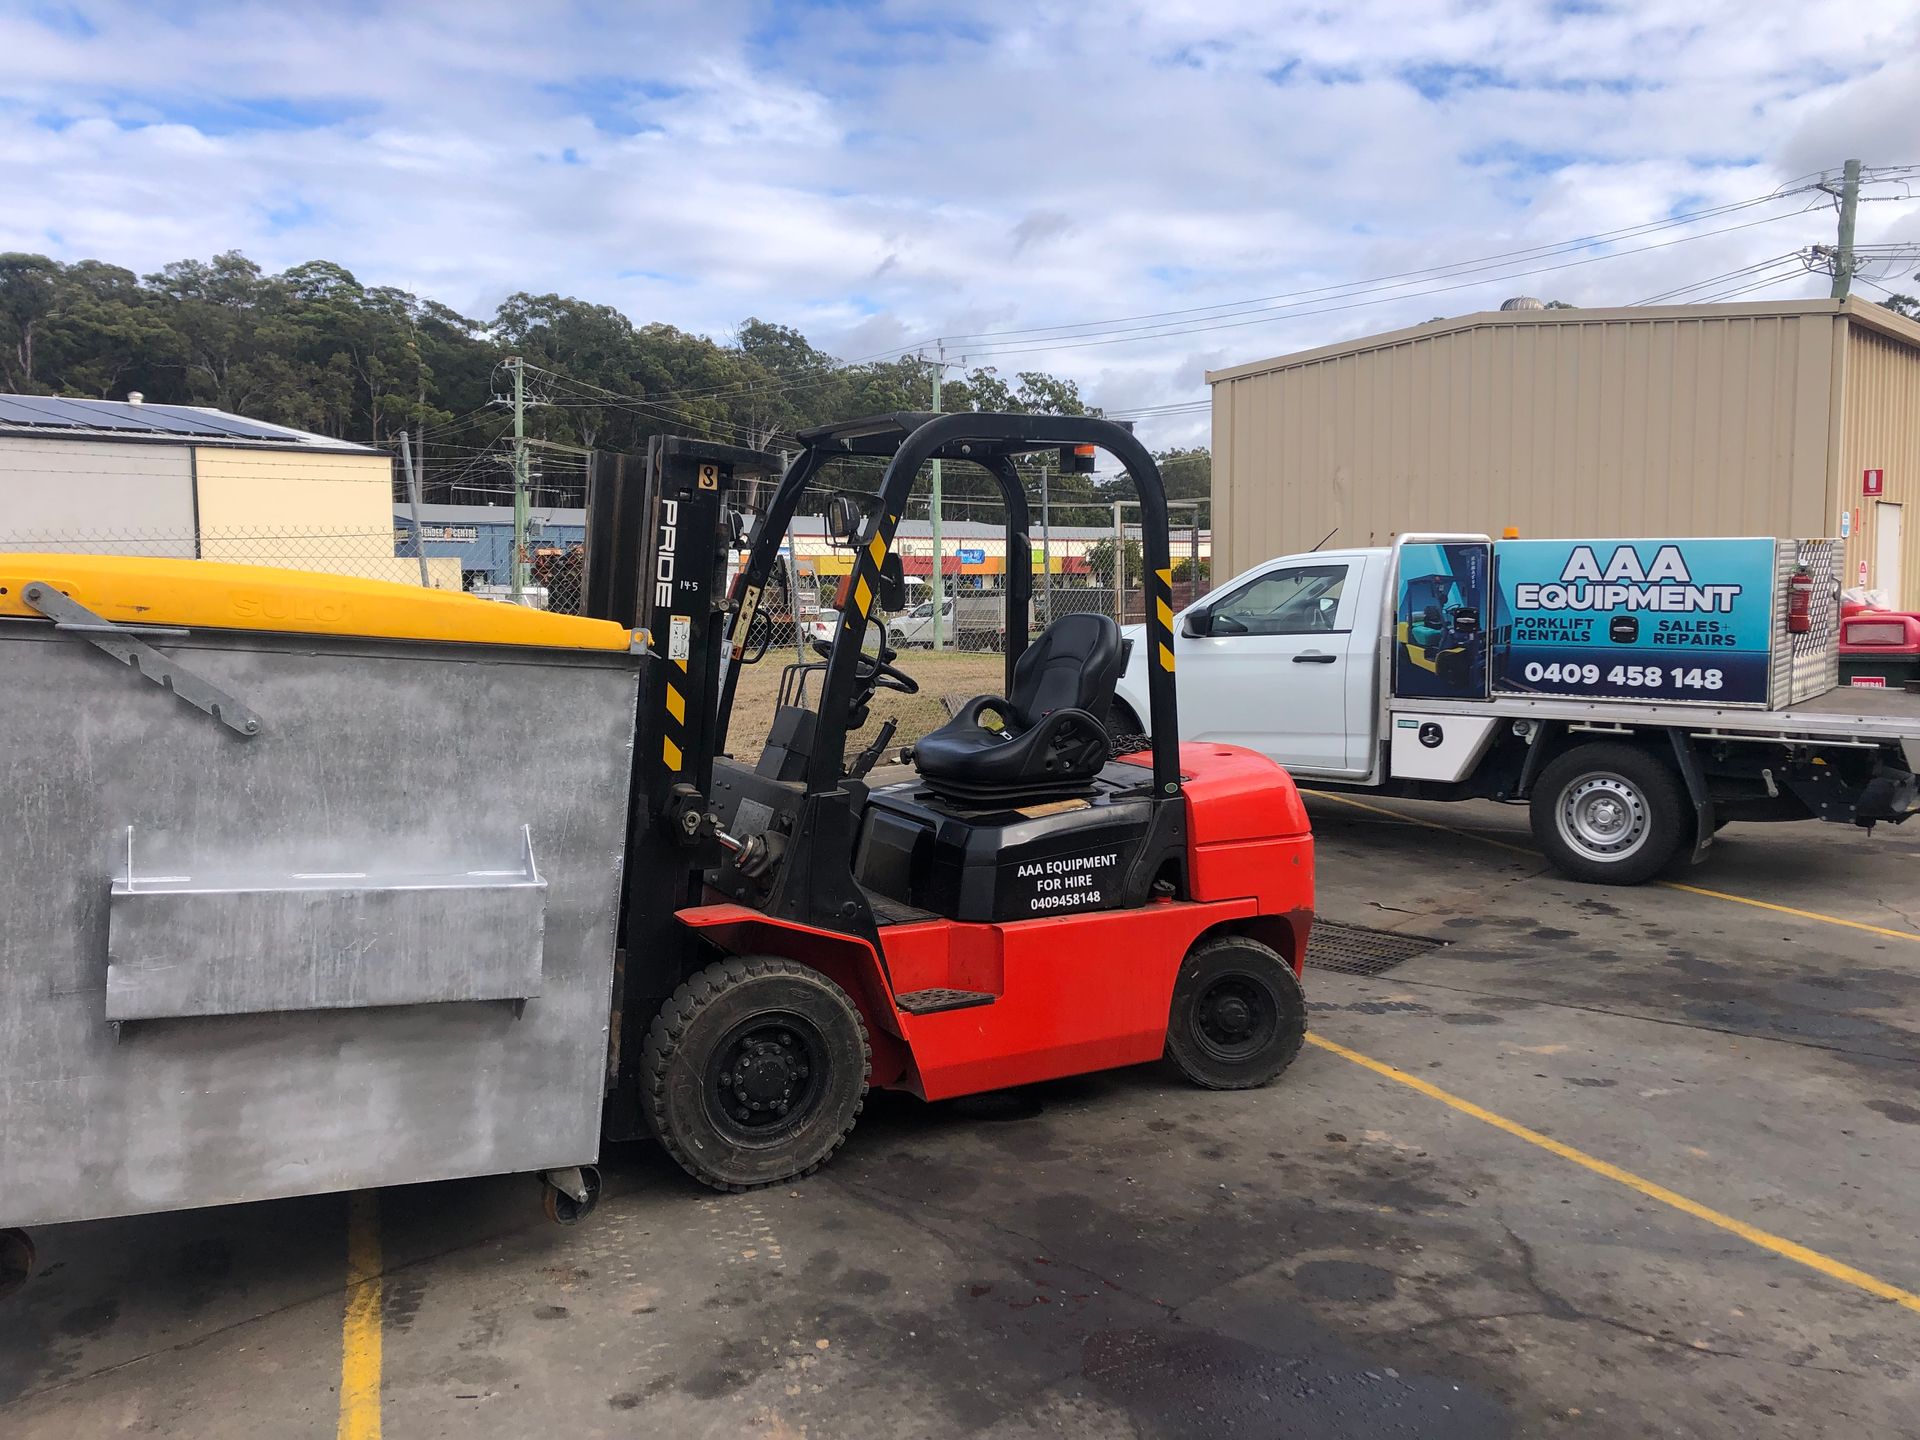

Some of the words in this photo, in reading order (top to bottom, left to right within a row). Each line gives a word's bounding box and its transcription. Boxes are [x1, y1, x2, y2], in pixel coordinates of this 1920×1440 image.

[655, 499, 678, 608] PRIDE
[1560, 546, 1692, 582] AAA
[680, 580, 699, 592] 145
[1516, 584, 1742, 613] EQUIPMENT
[233, 598, 343, 622] SULO
[1514, 617, 1594, 630] FORKLIFT
[1517, 630, 1591, 642] RENTALS
[1653, 633, 1737, 646] REPAIRS
[1524, 662, 1600, 684] 0409
[1607, 665, 1663, 687] 458
[1670, 667, 1724, 690] 148
[1017, 863, 1043, 877] AAA
[1046, 854, 1117, 875] EQUIPMENT
[1037, 878, 1061, 892] FOR
[1065, 874, 1093, 889] HIRE
[1030, 891, 1101, 910] 0409458148
